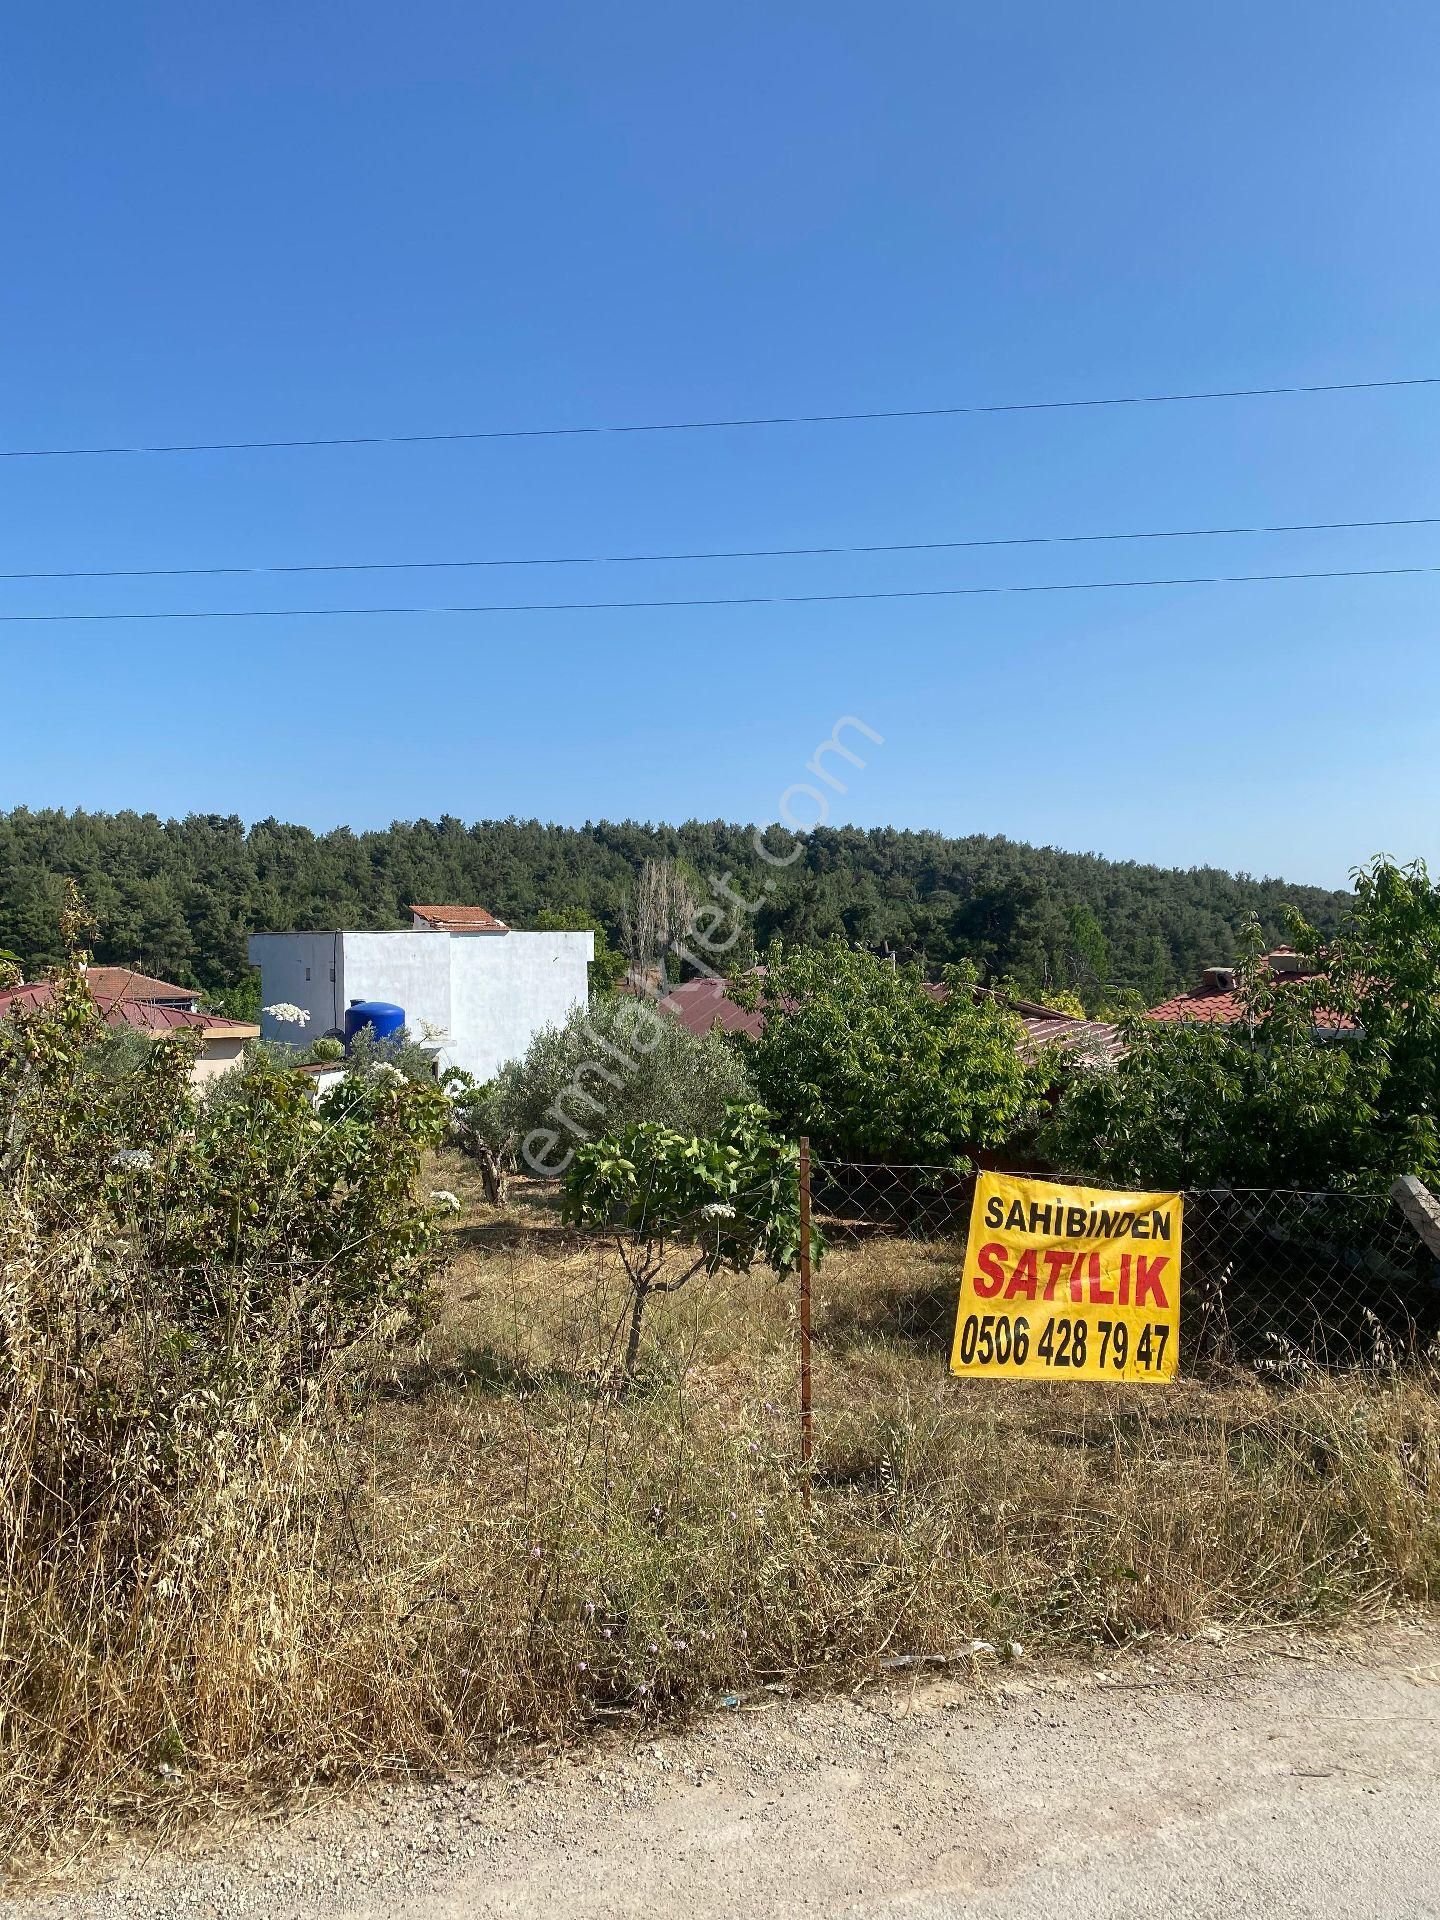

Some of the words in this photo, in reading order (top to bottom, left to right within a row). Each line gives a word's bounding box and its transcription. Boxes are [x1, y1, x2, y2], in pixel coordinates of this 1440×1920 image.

[984, 1196, 1171, 1241] SAHİBİNDEN
[973, 1242, 1170, 1309] SATILIK
[960, 1314, 1030, 1365] 0506
[1037, 1317, 1088, 1368] 428
[1097, 1320, 1129, 1370] 79
[1136, 1324, 1170, 1371] 47
